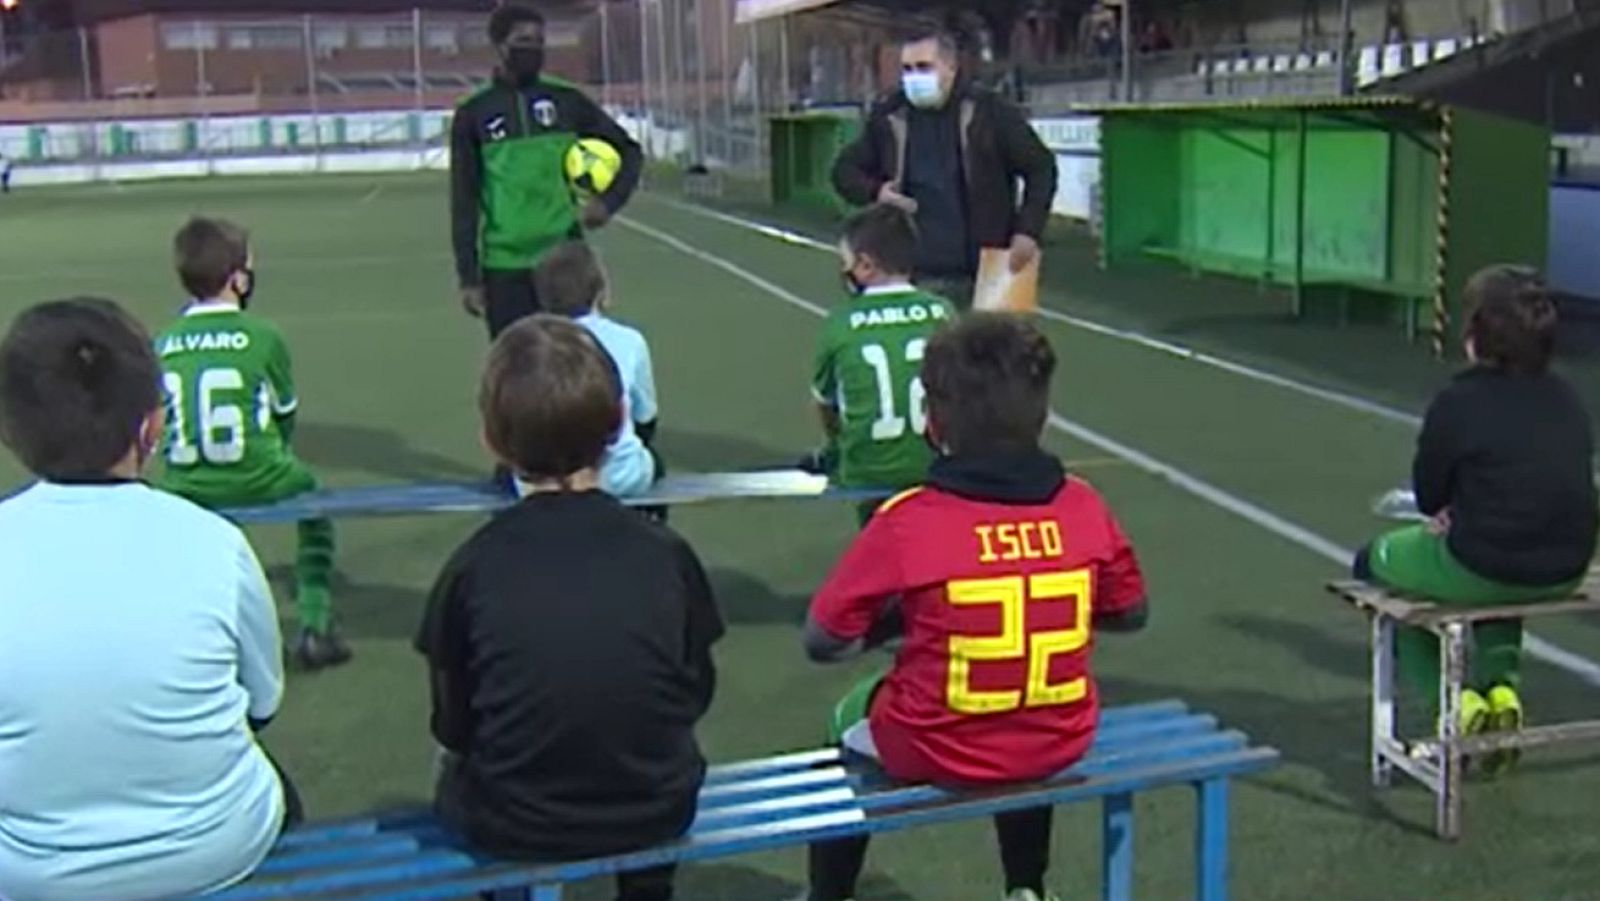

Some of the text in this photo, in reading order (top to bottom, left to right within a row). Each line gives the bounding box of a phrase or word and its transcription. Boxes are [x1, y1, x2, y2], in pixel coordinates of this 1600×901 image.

[850, 304, 928, 329] PABLO
[163, 368, 244, 465] 16
[974, 520, 1064, 562] ISCO
[947, 568, 1091, 714] 22
